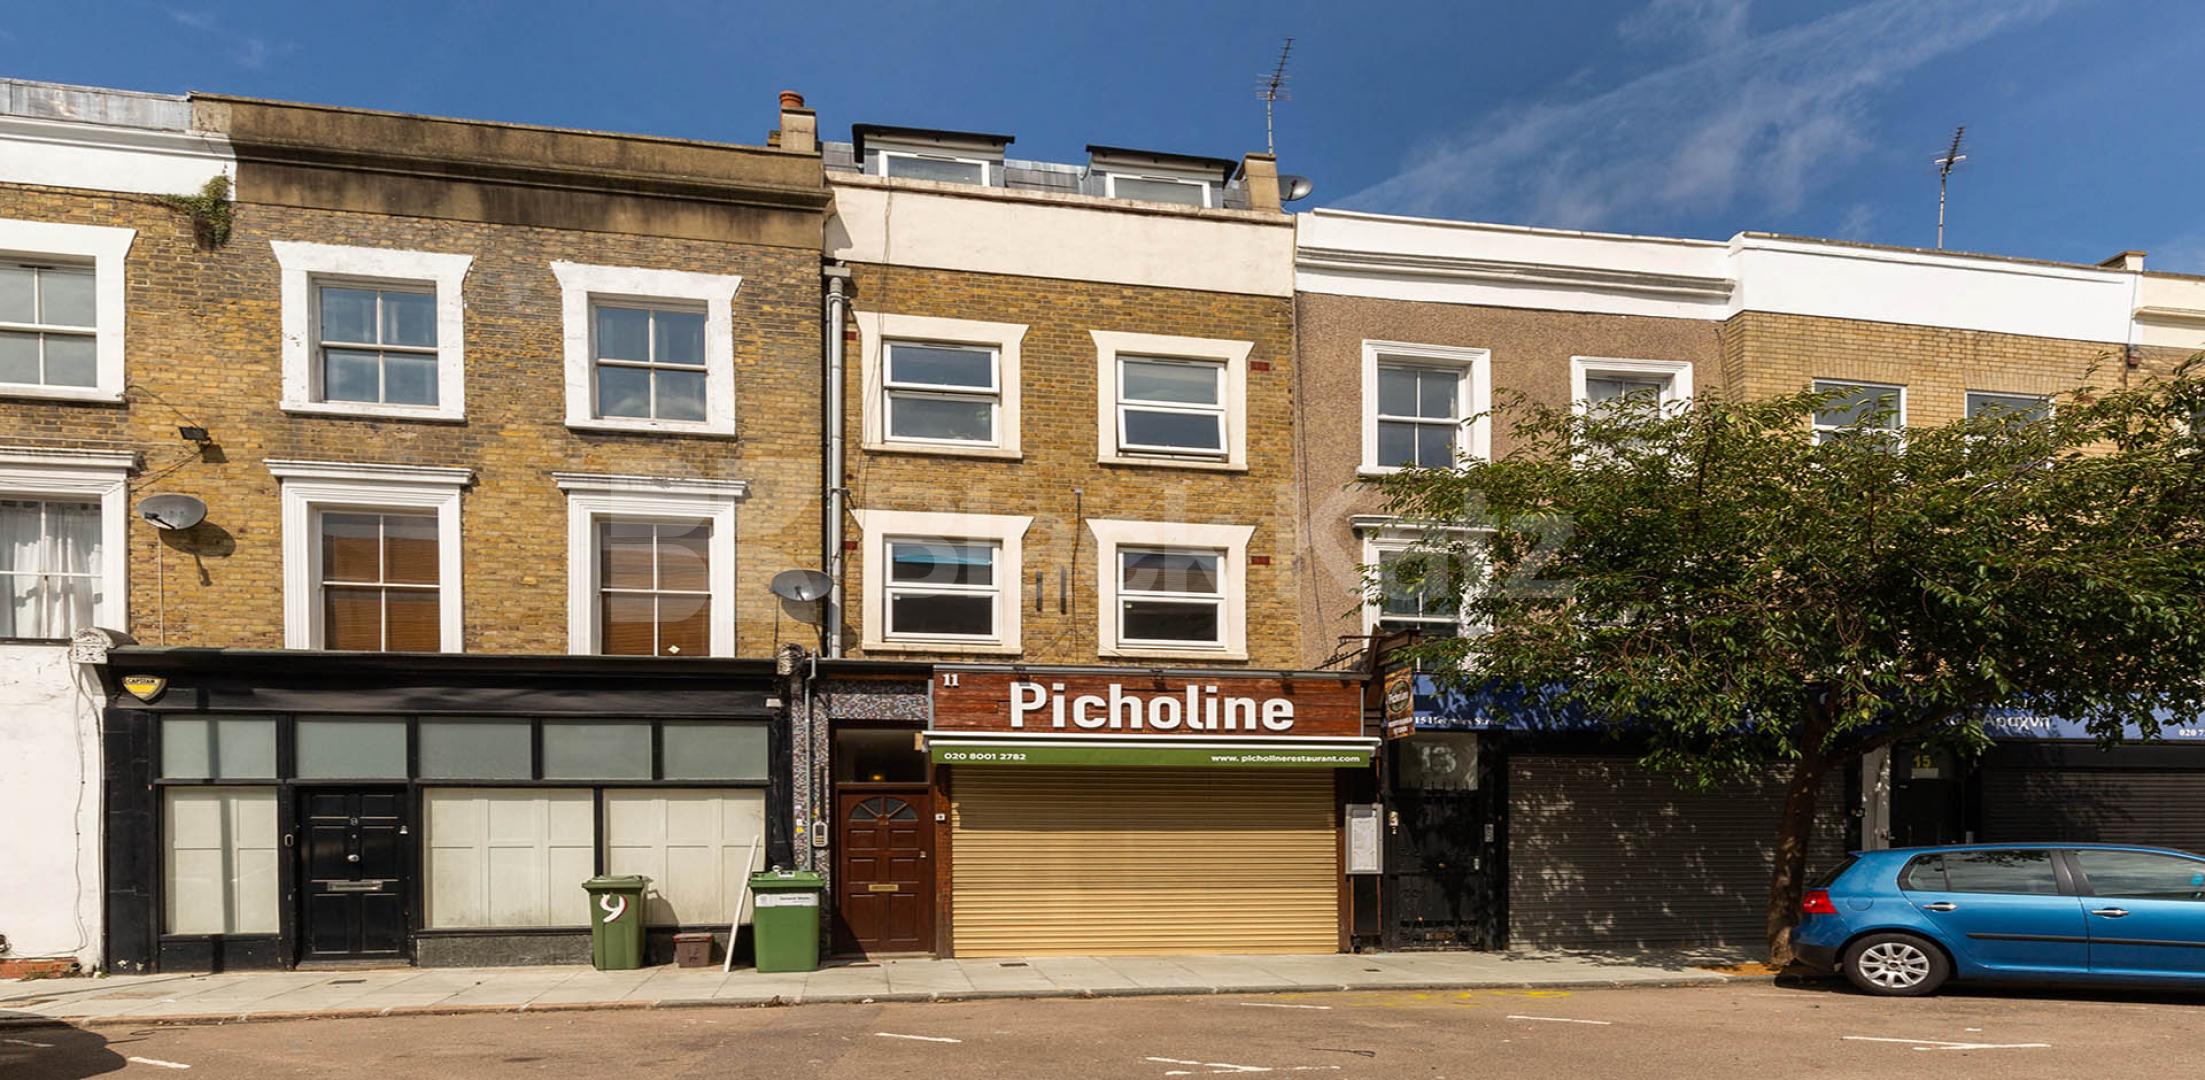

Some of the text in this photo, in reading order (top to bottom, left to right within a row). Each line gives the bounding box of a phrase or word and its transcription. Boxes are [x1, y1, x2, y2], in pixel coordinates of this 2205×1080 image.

[942, 674, 959, 687] 11
[1010, 682, 1294, 731] Picholine
[944, 752, 1027, 761] 020 8001 2782
[1241, 755, 1361, 764] picholinerestaurant.com
[599, 893, 628, 923] 9
